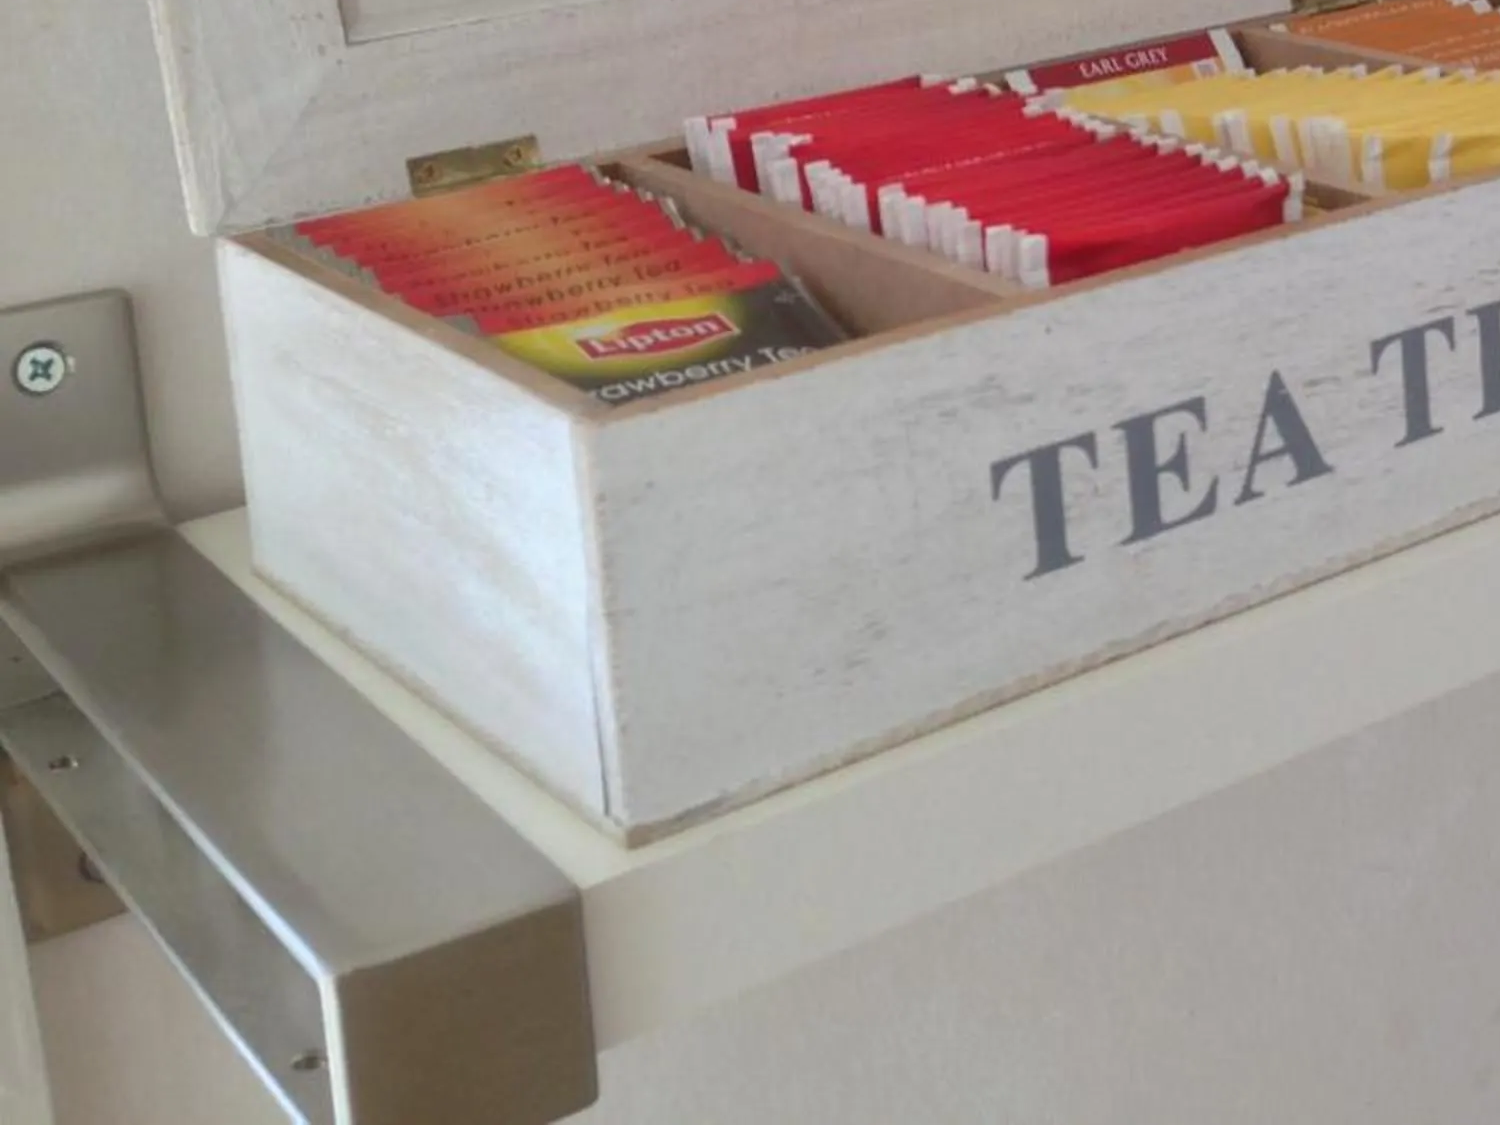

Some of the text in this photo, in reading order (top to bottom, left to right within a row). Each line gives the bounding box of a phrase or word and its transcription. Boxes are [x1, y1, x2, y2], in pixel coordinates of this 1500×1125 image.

[1079, 46, 1168, 79] EARL GREY
[585, 317, 722, 353] Lipton
[990, 368, 1335, 581] TEA
